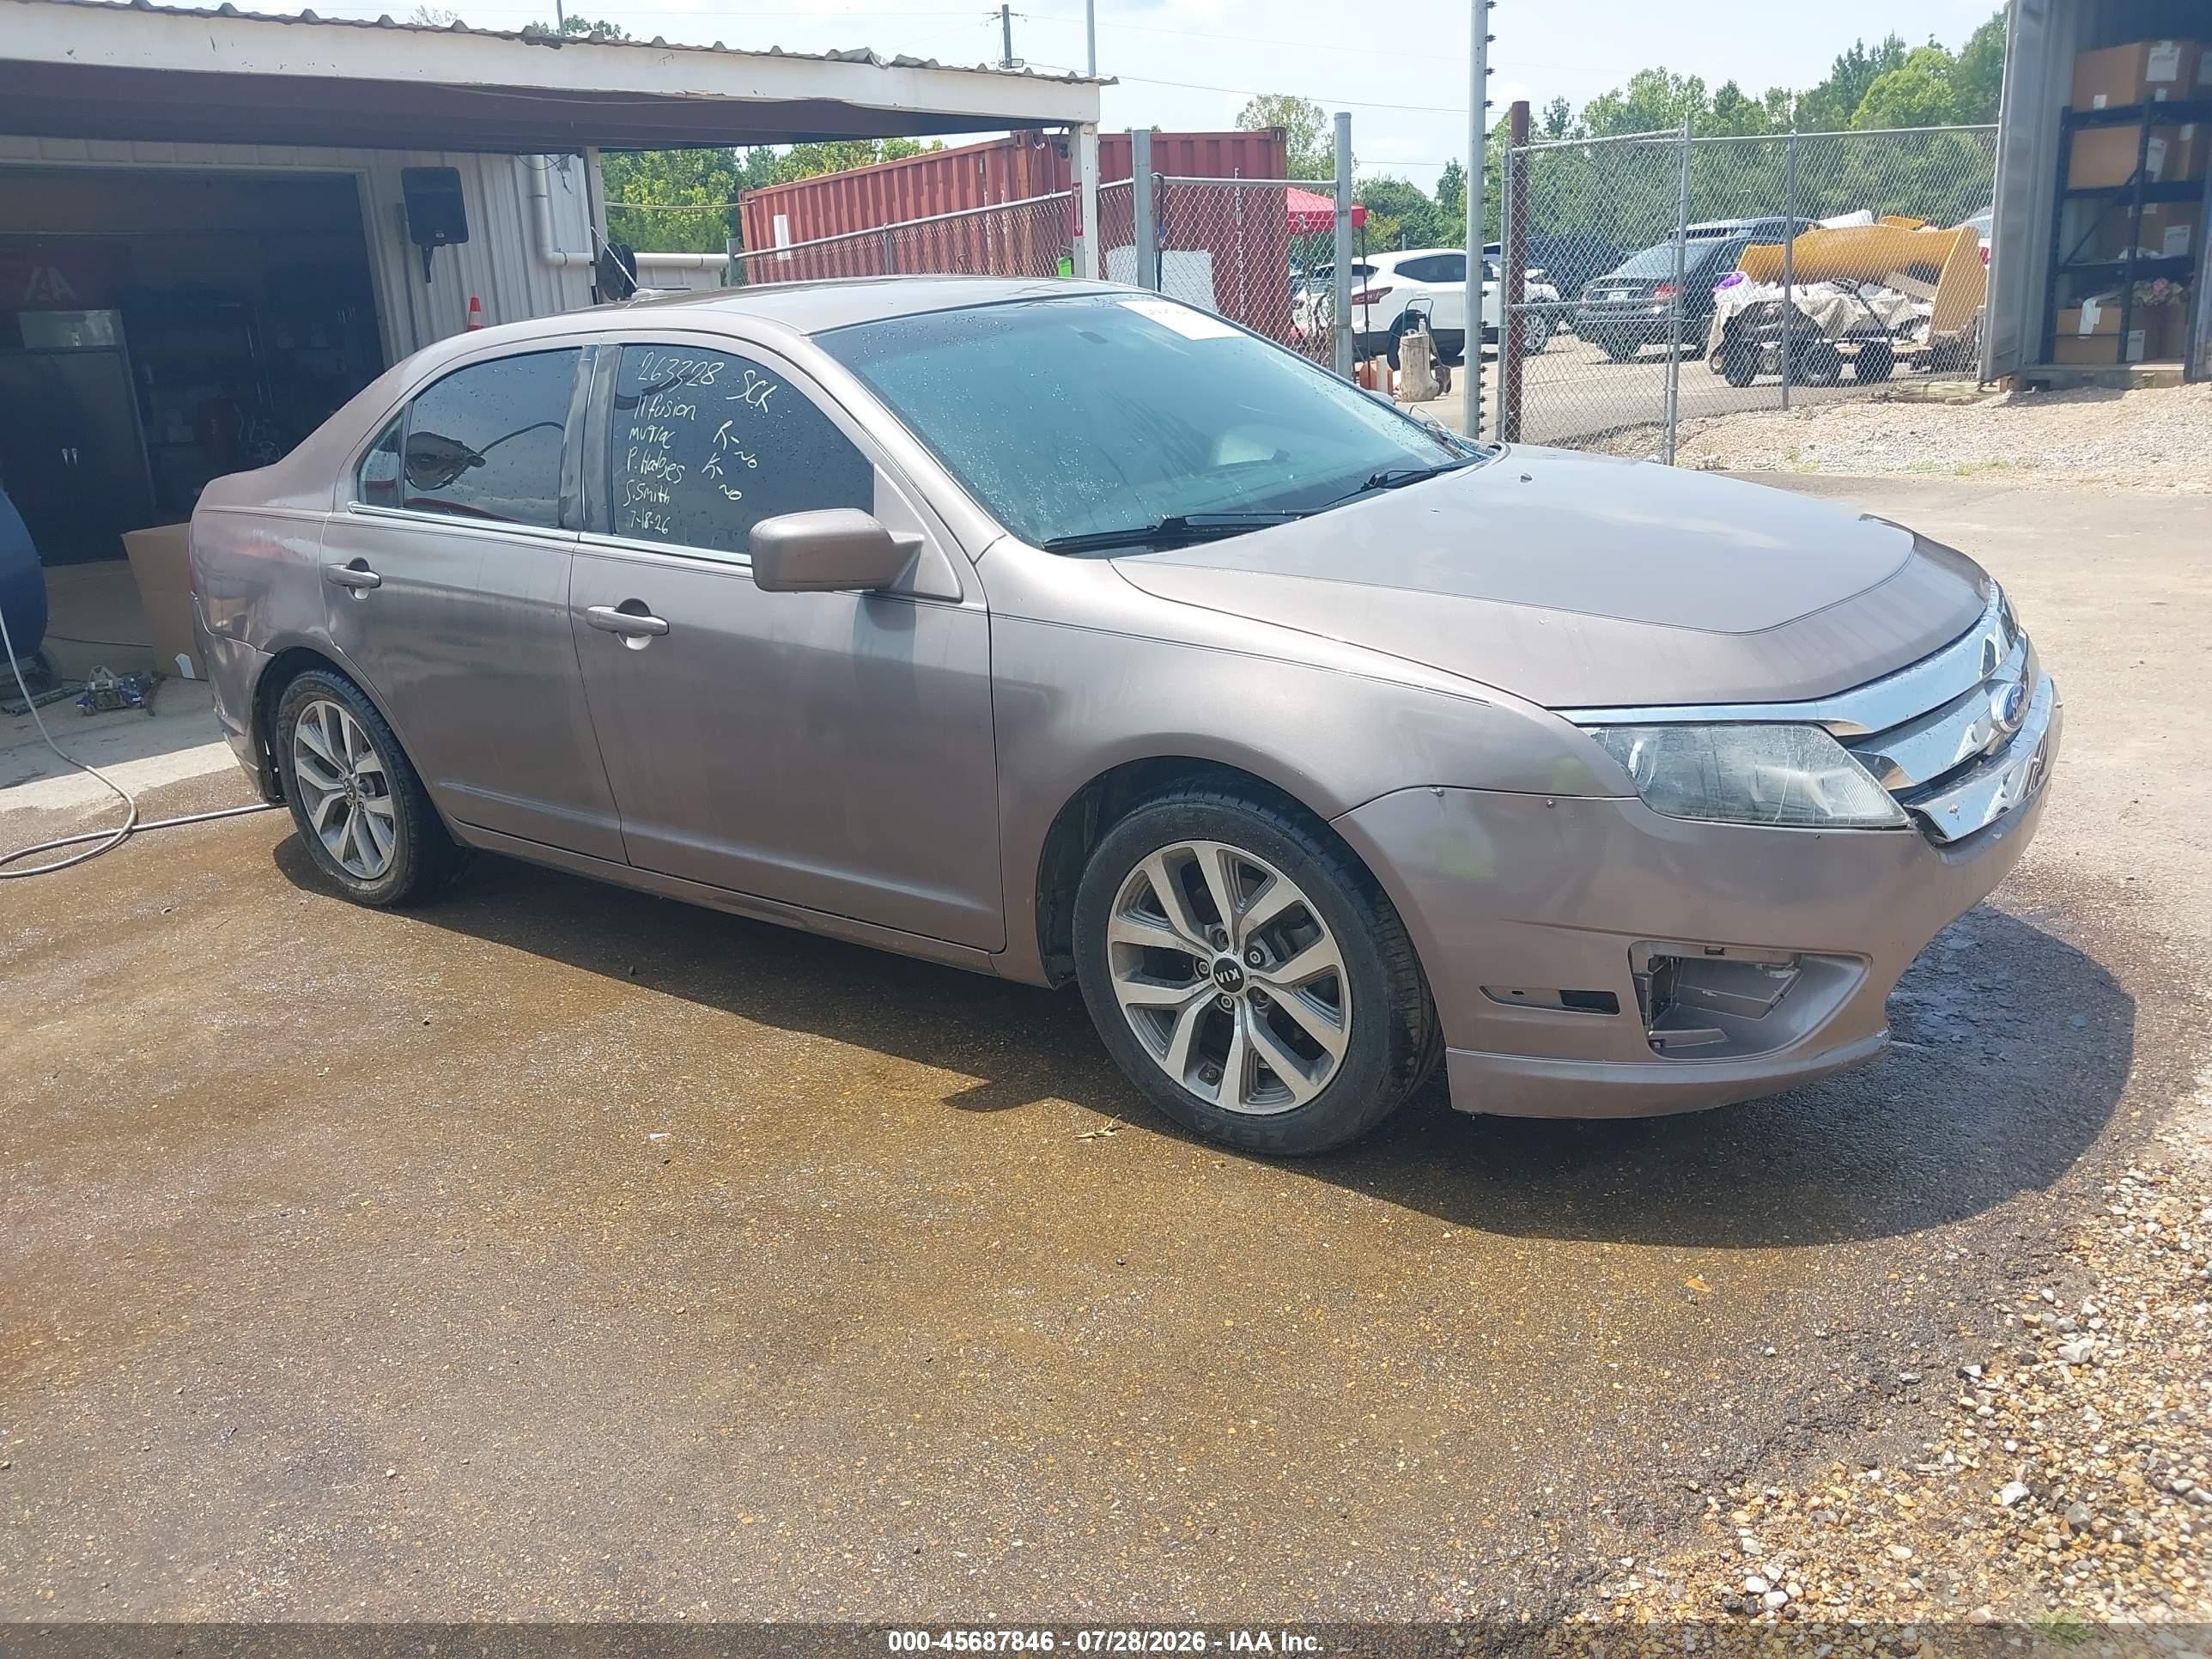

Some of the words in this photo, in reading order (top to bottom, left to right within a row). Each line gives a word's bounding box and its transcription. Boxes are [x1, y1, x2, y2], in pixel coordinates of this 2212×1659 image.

[637, 351, 725, 393] 263328
[630, 508, 671, 534] 7-18-26
[1215, 968, 1241, 983] KIA
